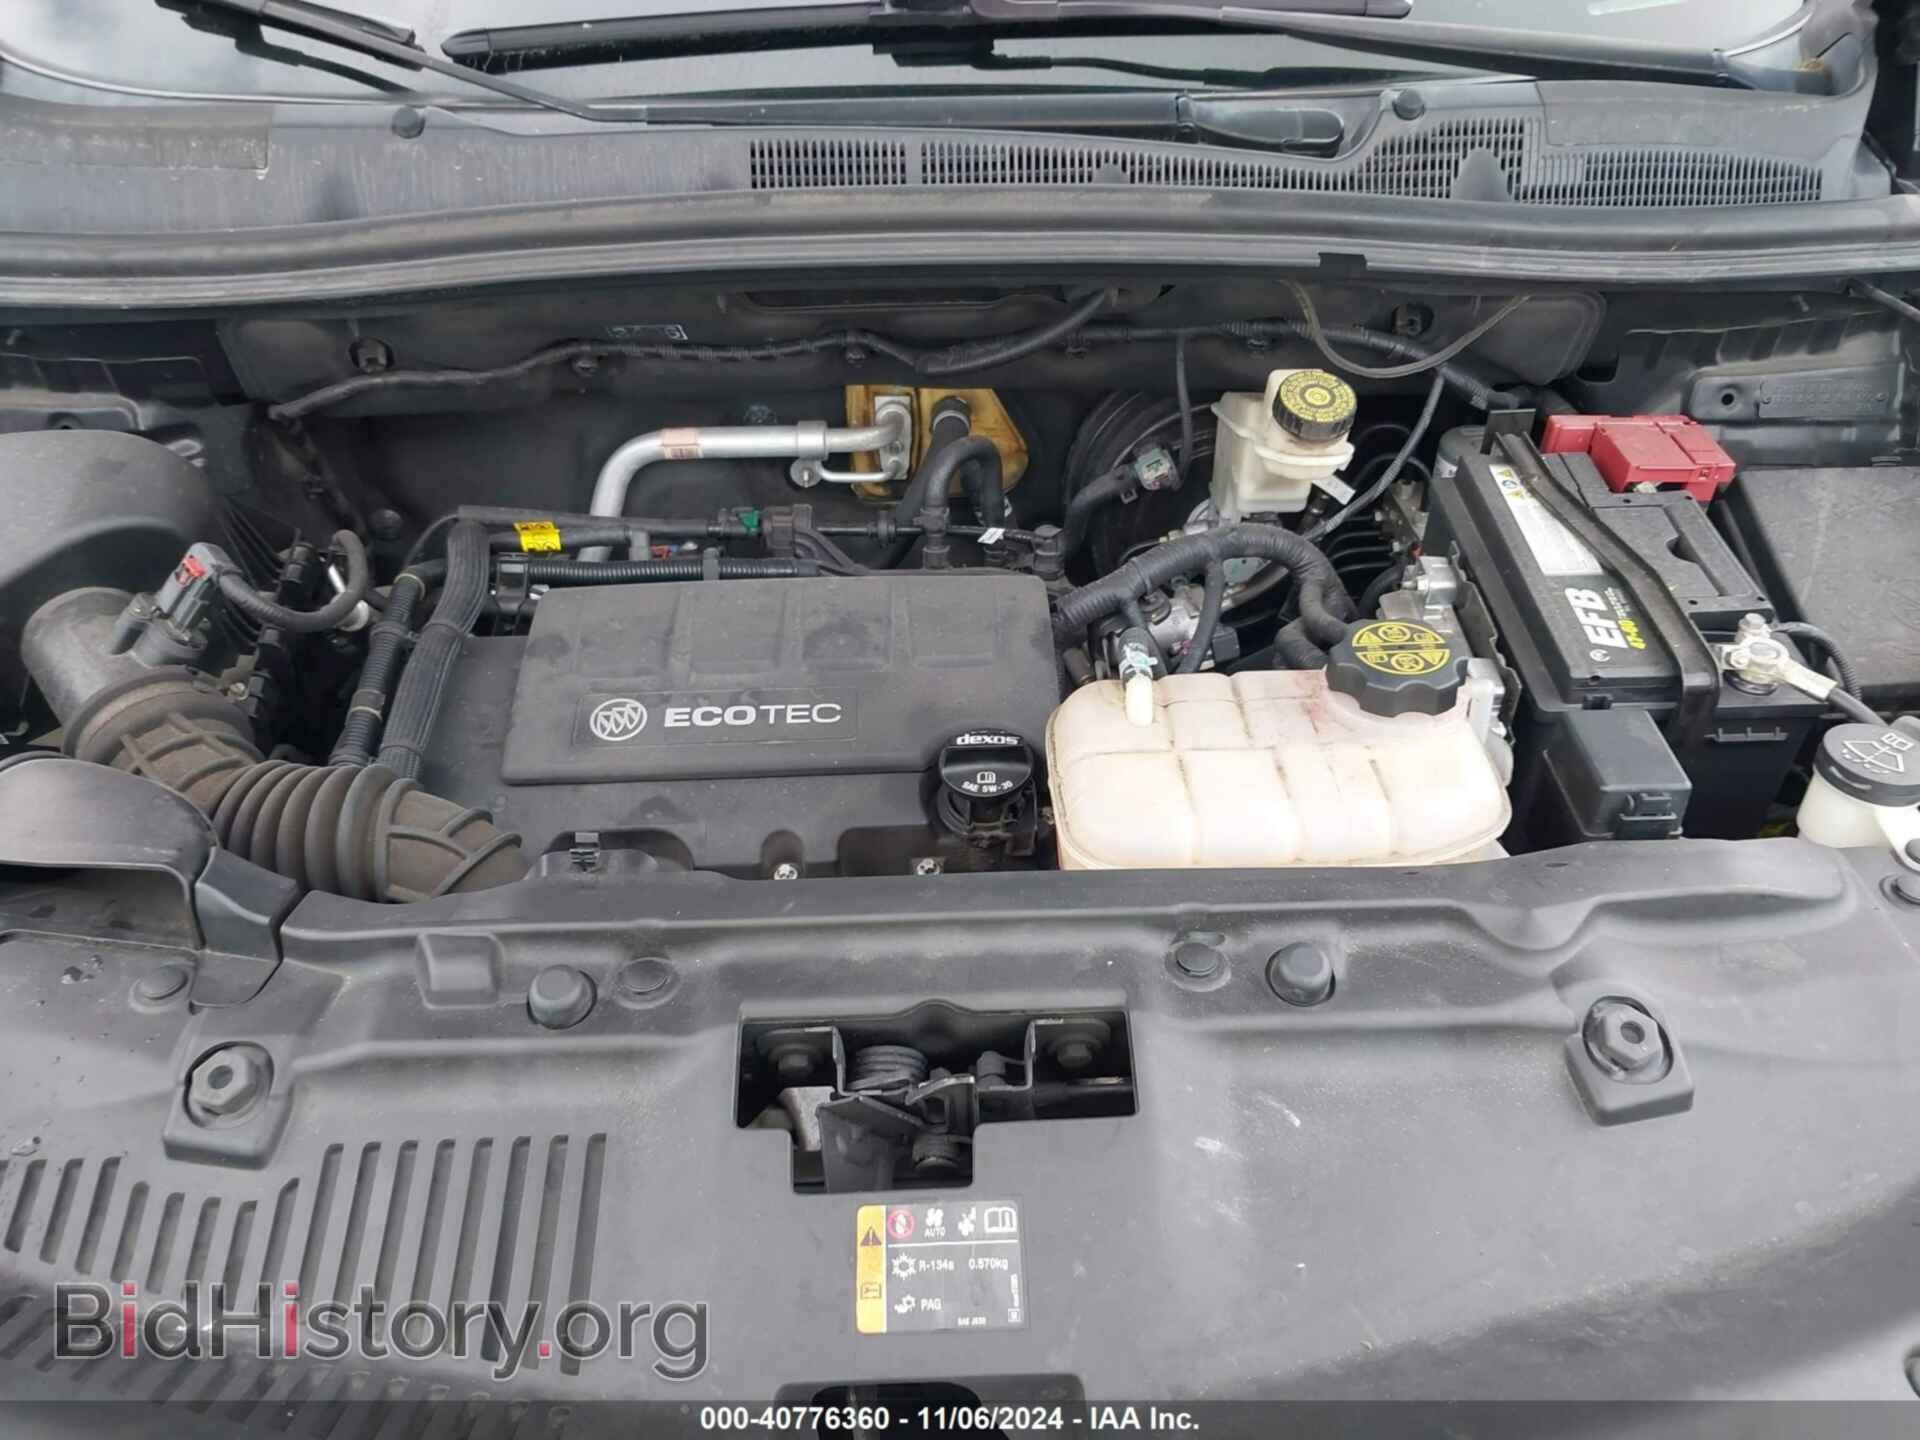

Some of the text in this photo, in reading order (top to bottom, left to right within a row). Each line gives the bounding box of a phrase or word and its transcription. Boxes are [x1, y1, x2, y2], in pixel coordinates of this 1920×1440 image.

[1564, 587, 1628, 648] EFB
[664, 703, 842, 727] ECOTEC
[956, 733, 1020, 745] dexos
[961, 780, 1014, 793] SAE 5W-30
[924, 1226, 945, 1238] AUTO
[921, 1298, 942, 1311] PAG
